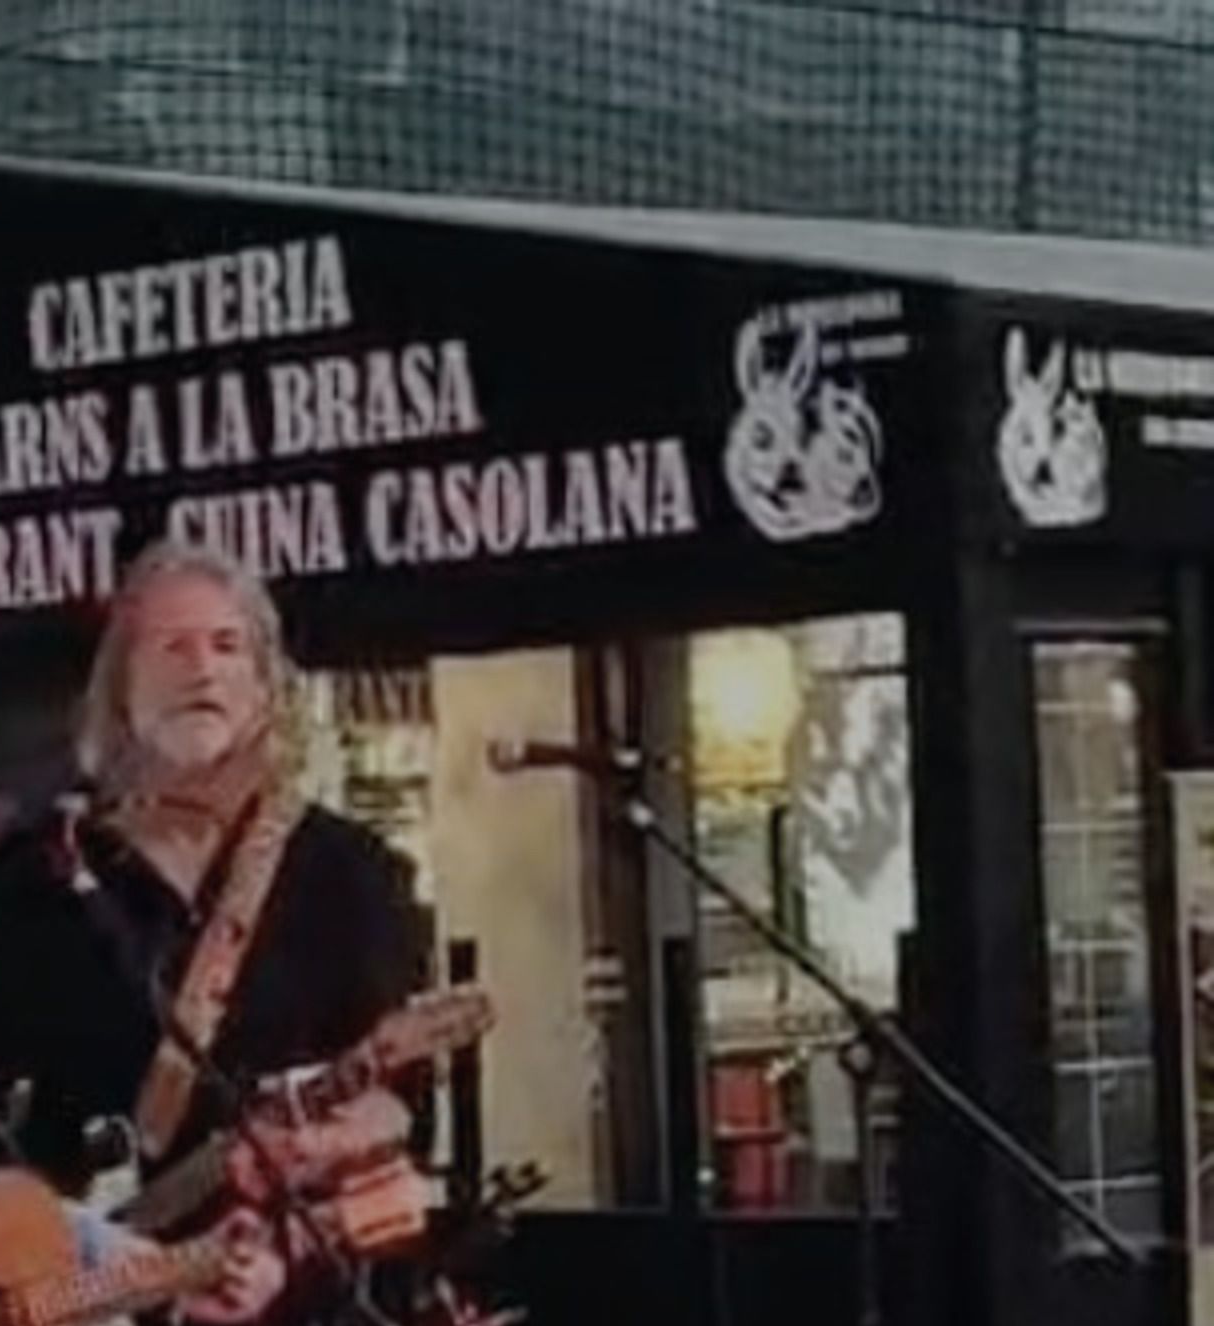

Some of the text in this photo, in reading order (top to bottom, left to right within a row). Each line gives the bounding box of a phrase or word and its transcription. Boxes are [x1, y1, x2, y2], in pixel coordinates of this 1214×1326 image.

[28, 234, 352, 372] CAFETERIA
[125, 385, 169, 477] A
[178, 372, 256, 471] LA
[268, 339, 481, 458] BRASA
[366, 436, 697, 565] CASOLANA
